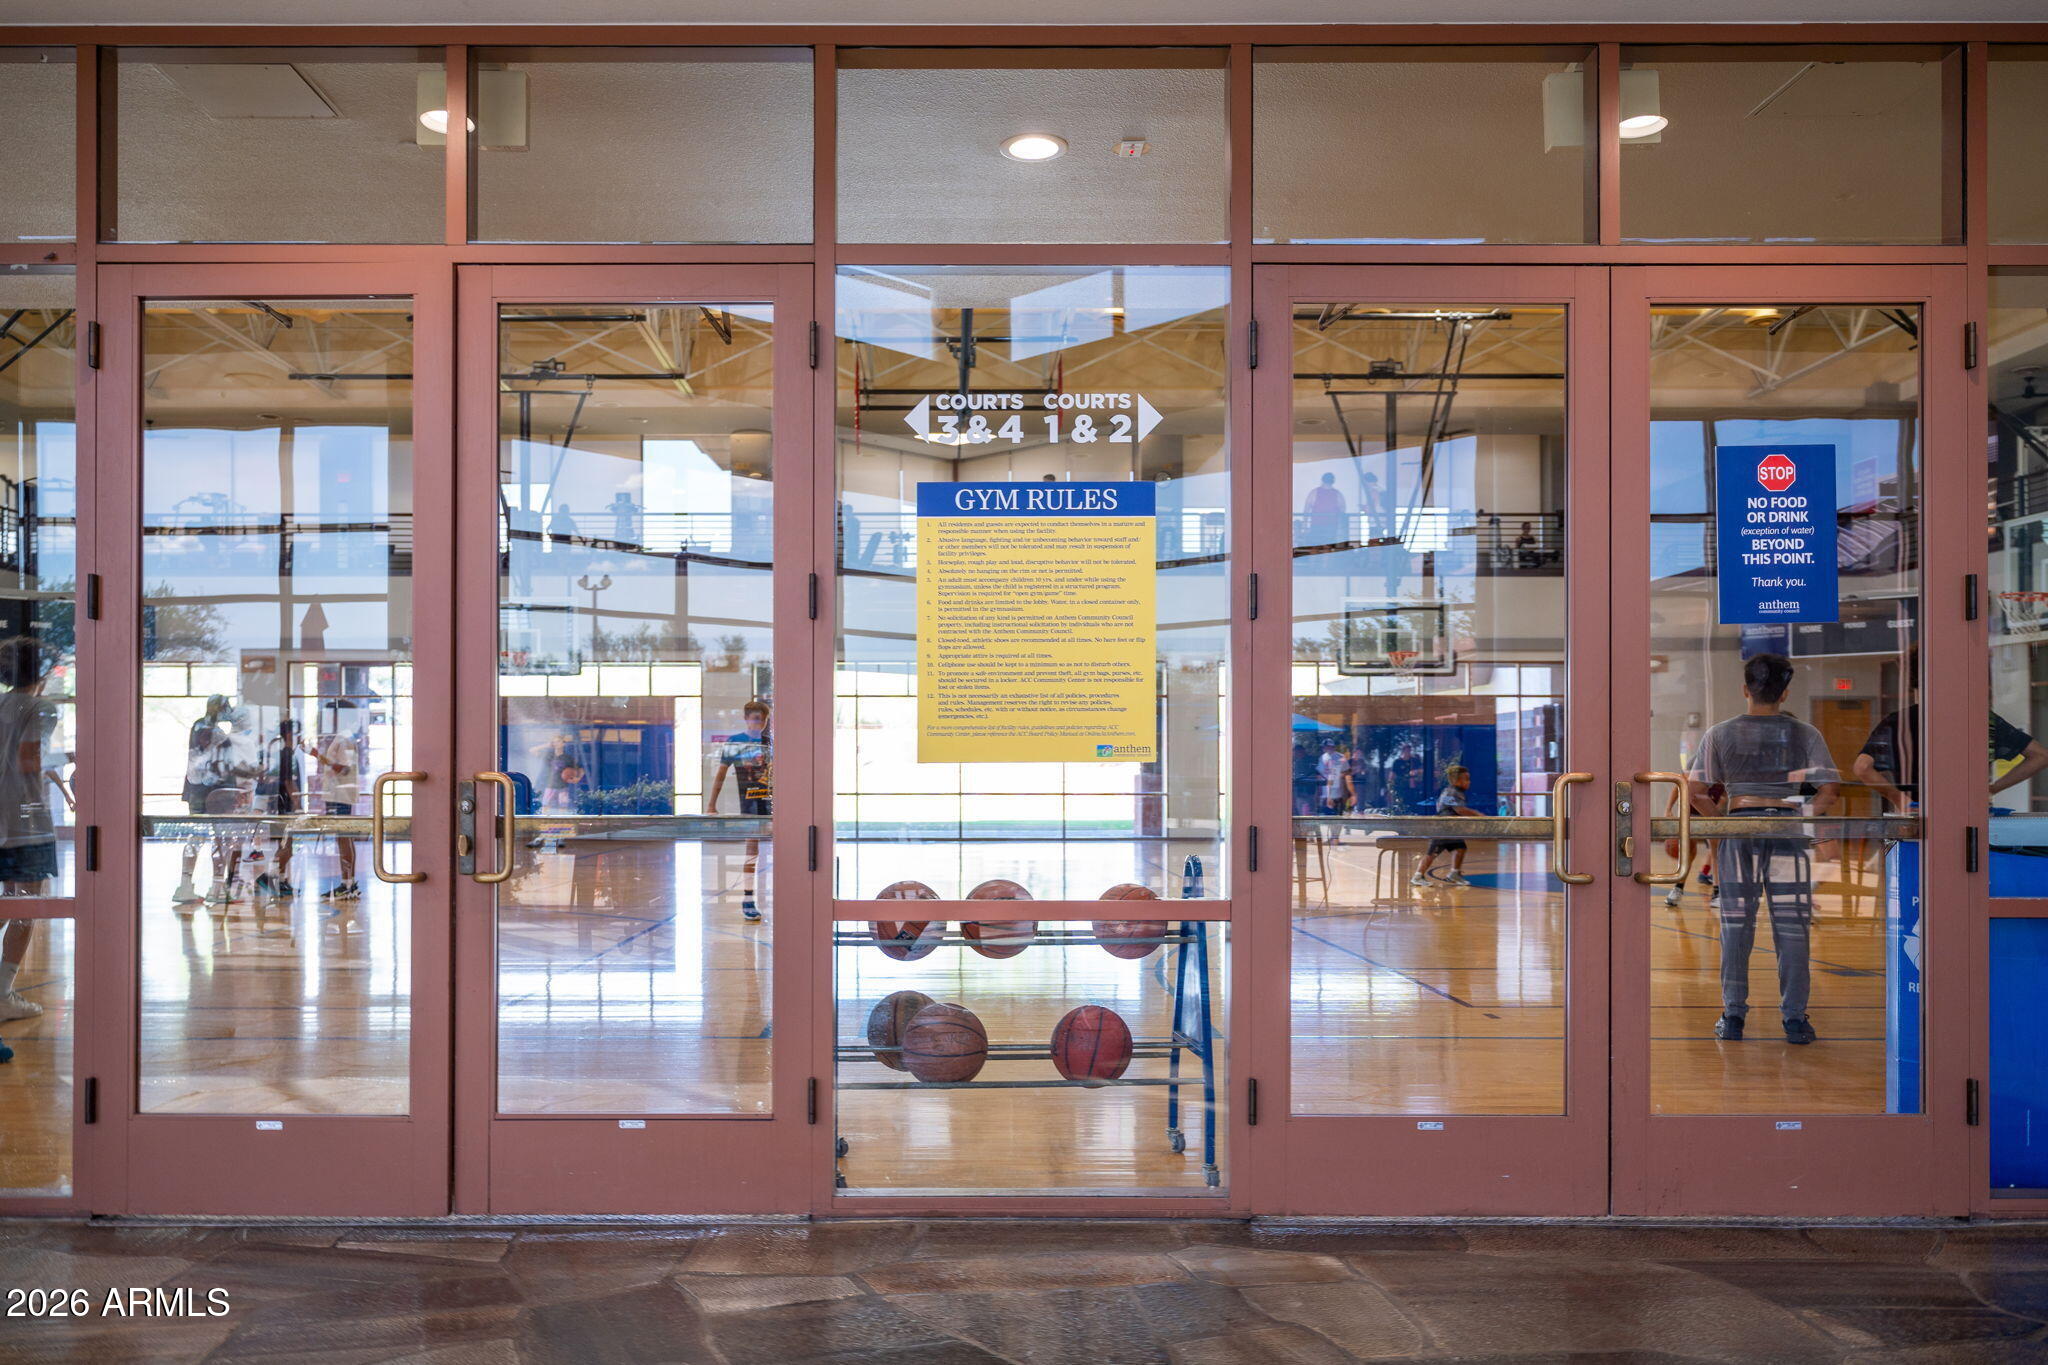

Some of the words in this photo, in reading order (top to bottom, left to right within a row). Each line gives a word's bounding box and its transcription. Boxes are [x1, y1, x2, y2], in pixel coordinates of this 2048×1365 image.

[936, 394, 1024, 410] COURTS
[1044, 393, 1131, 409] COURTS
[1760, 467, 1793, 480] STOP
[955, 489, 1019, 510] GYM
[1026, 489, 1118, 510] RULES
[1747, 498, 1768, 508] NO
[1771, 497, 1807, 508] FOOD
[1747, 512, 1765, 523] OR
[1769, 512, 1808, 522] DRINK
[1741, 526, 1779, 536] (exception
[1781, 526, 1790, 535] of
[1790, 526, 1814, 536] water)
[1752, 539, 1804, 550] BEYOND
[1742, 554, 1771, 565] THIS
[1774, 553, 1815, 564] POINT.
[1752, 577, 1783, 587] Thank
[1785, 578, 1806, 589] you.
[1759, 600, 1800, 609] anthem
[1114, 744, 1151, 753] anthem
